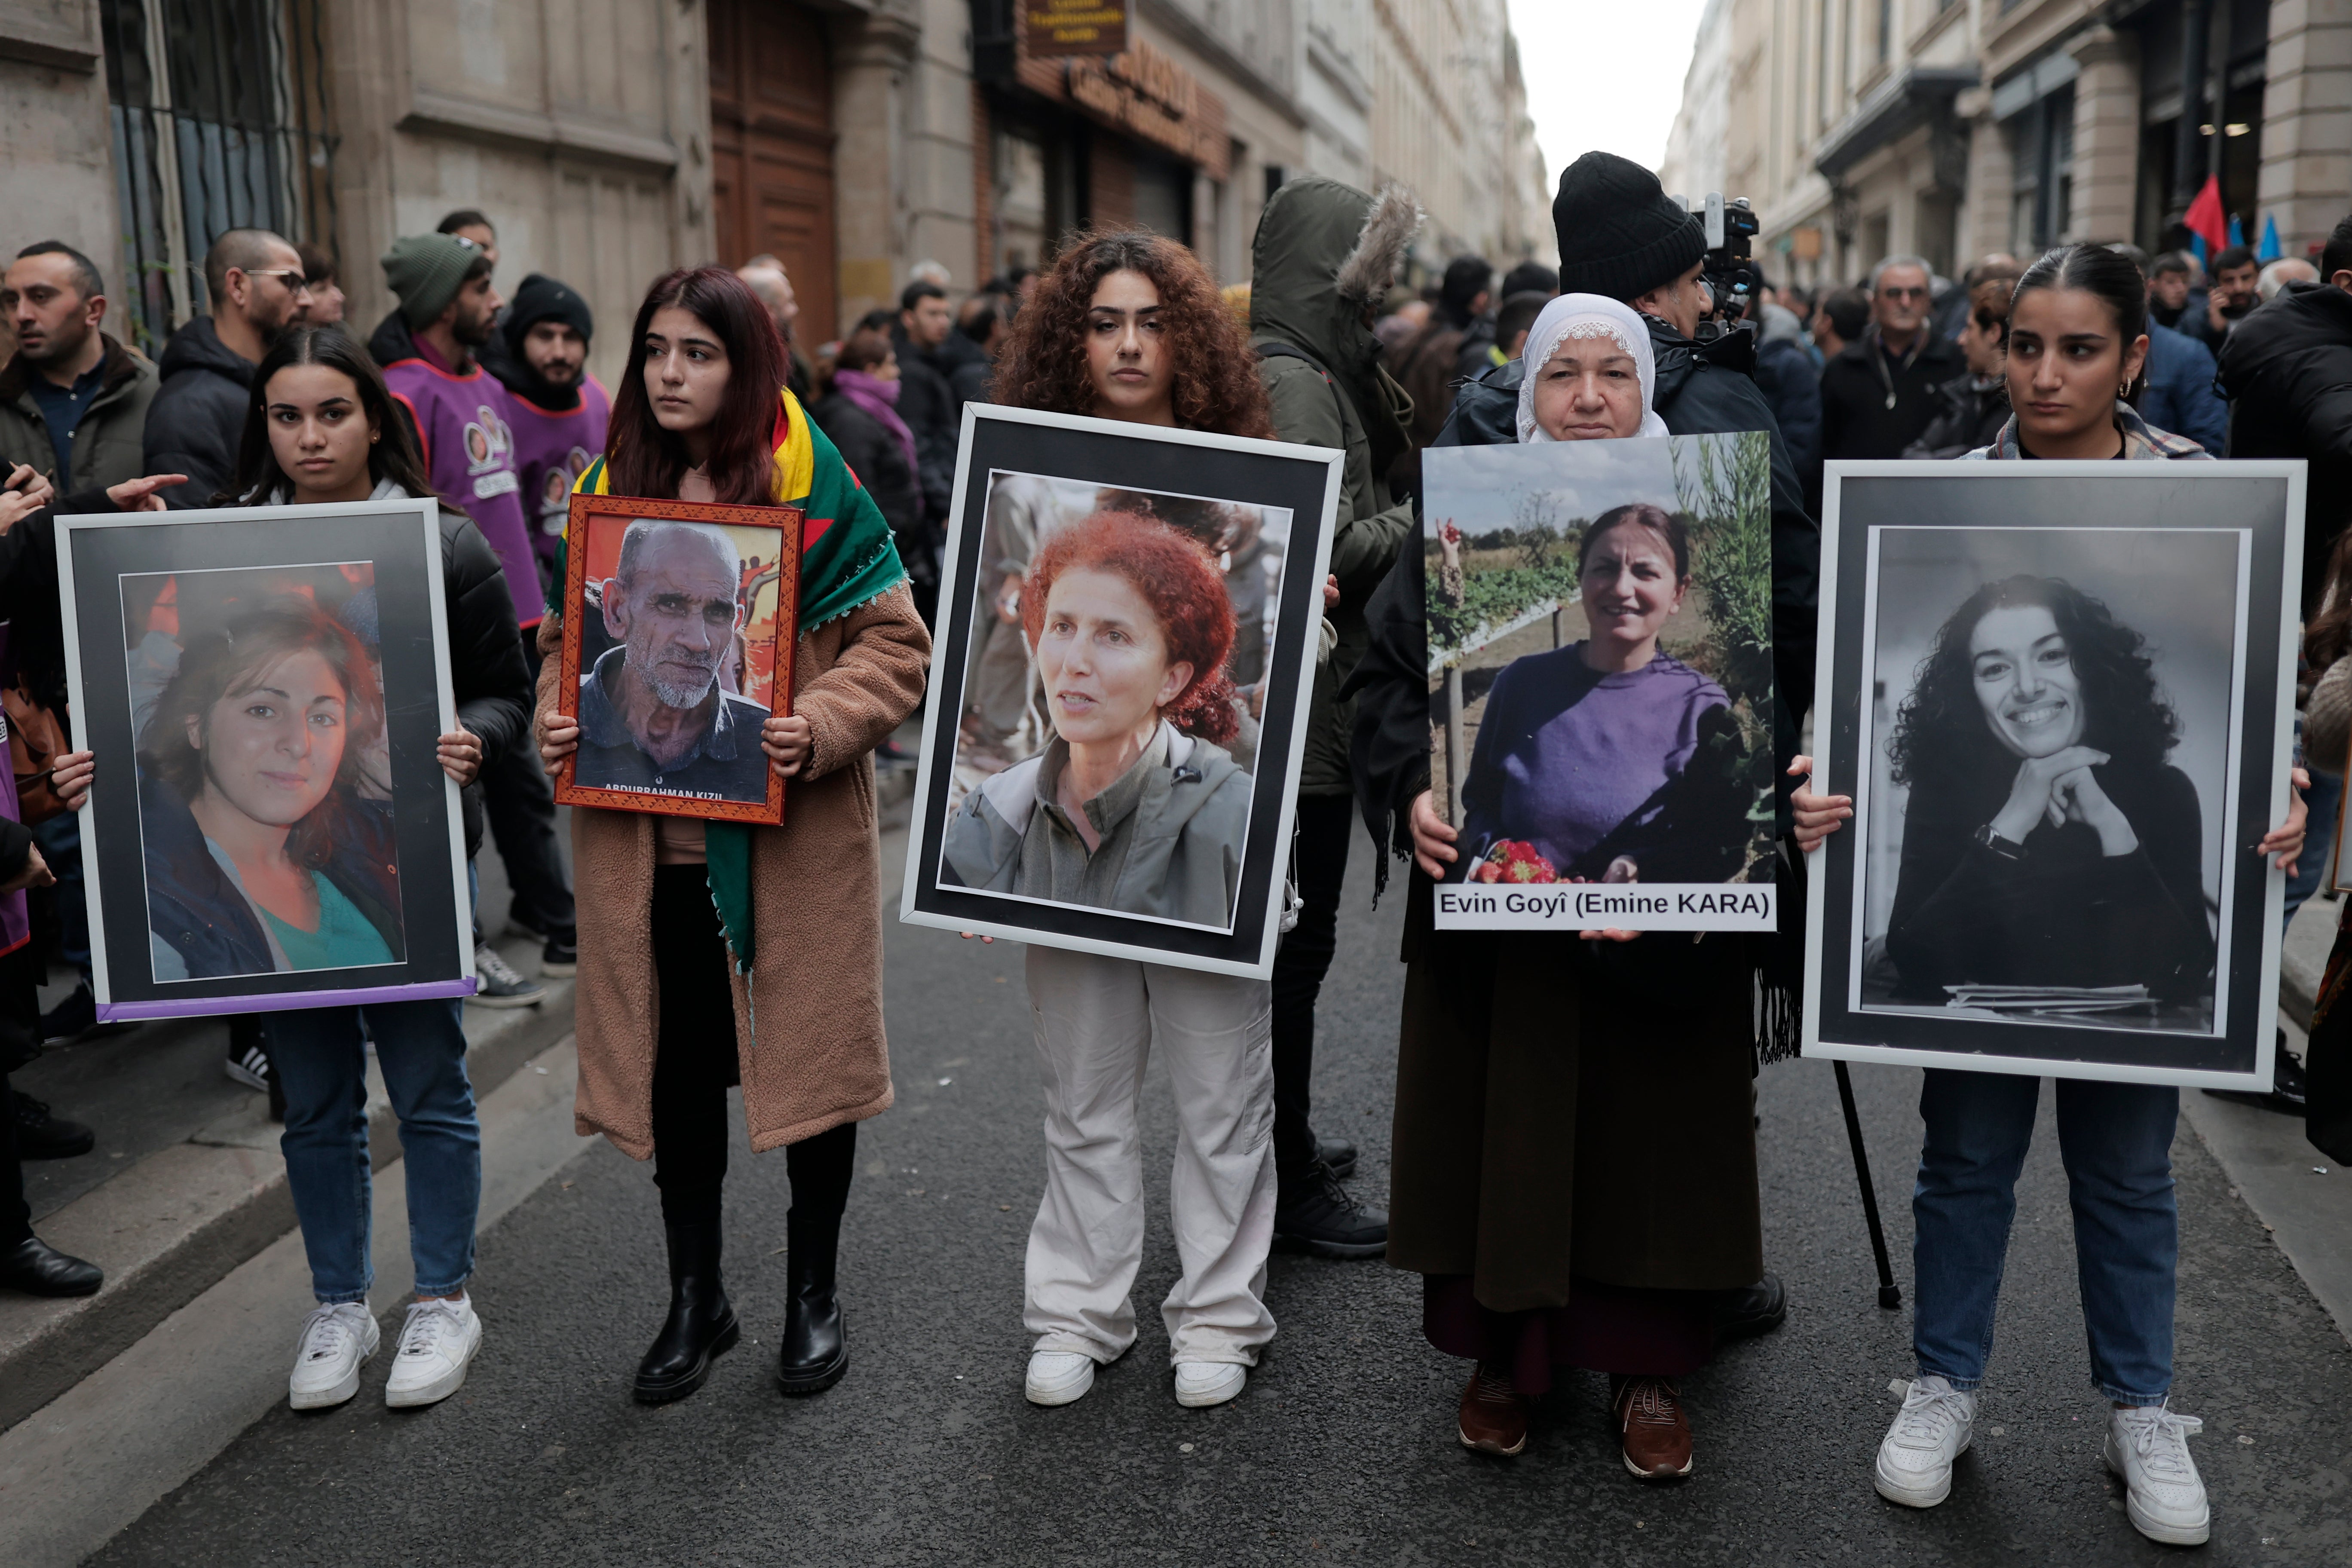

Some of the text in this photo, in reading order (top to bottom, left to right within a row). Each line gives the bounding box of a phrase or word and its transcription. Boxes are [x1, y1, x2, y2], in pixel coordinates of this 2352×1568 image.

[605, 784, 693, 798] ABDURRAHMAN
[1441, 892, 1769, 919] Evin Goyî (Emine KARA)
